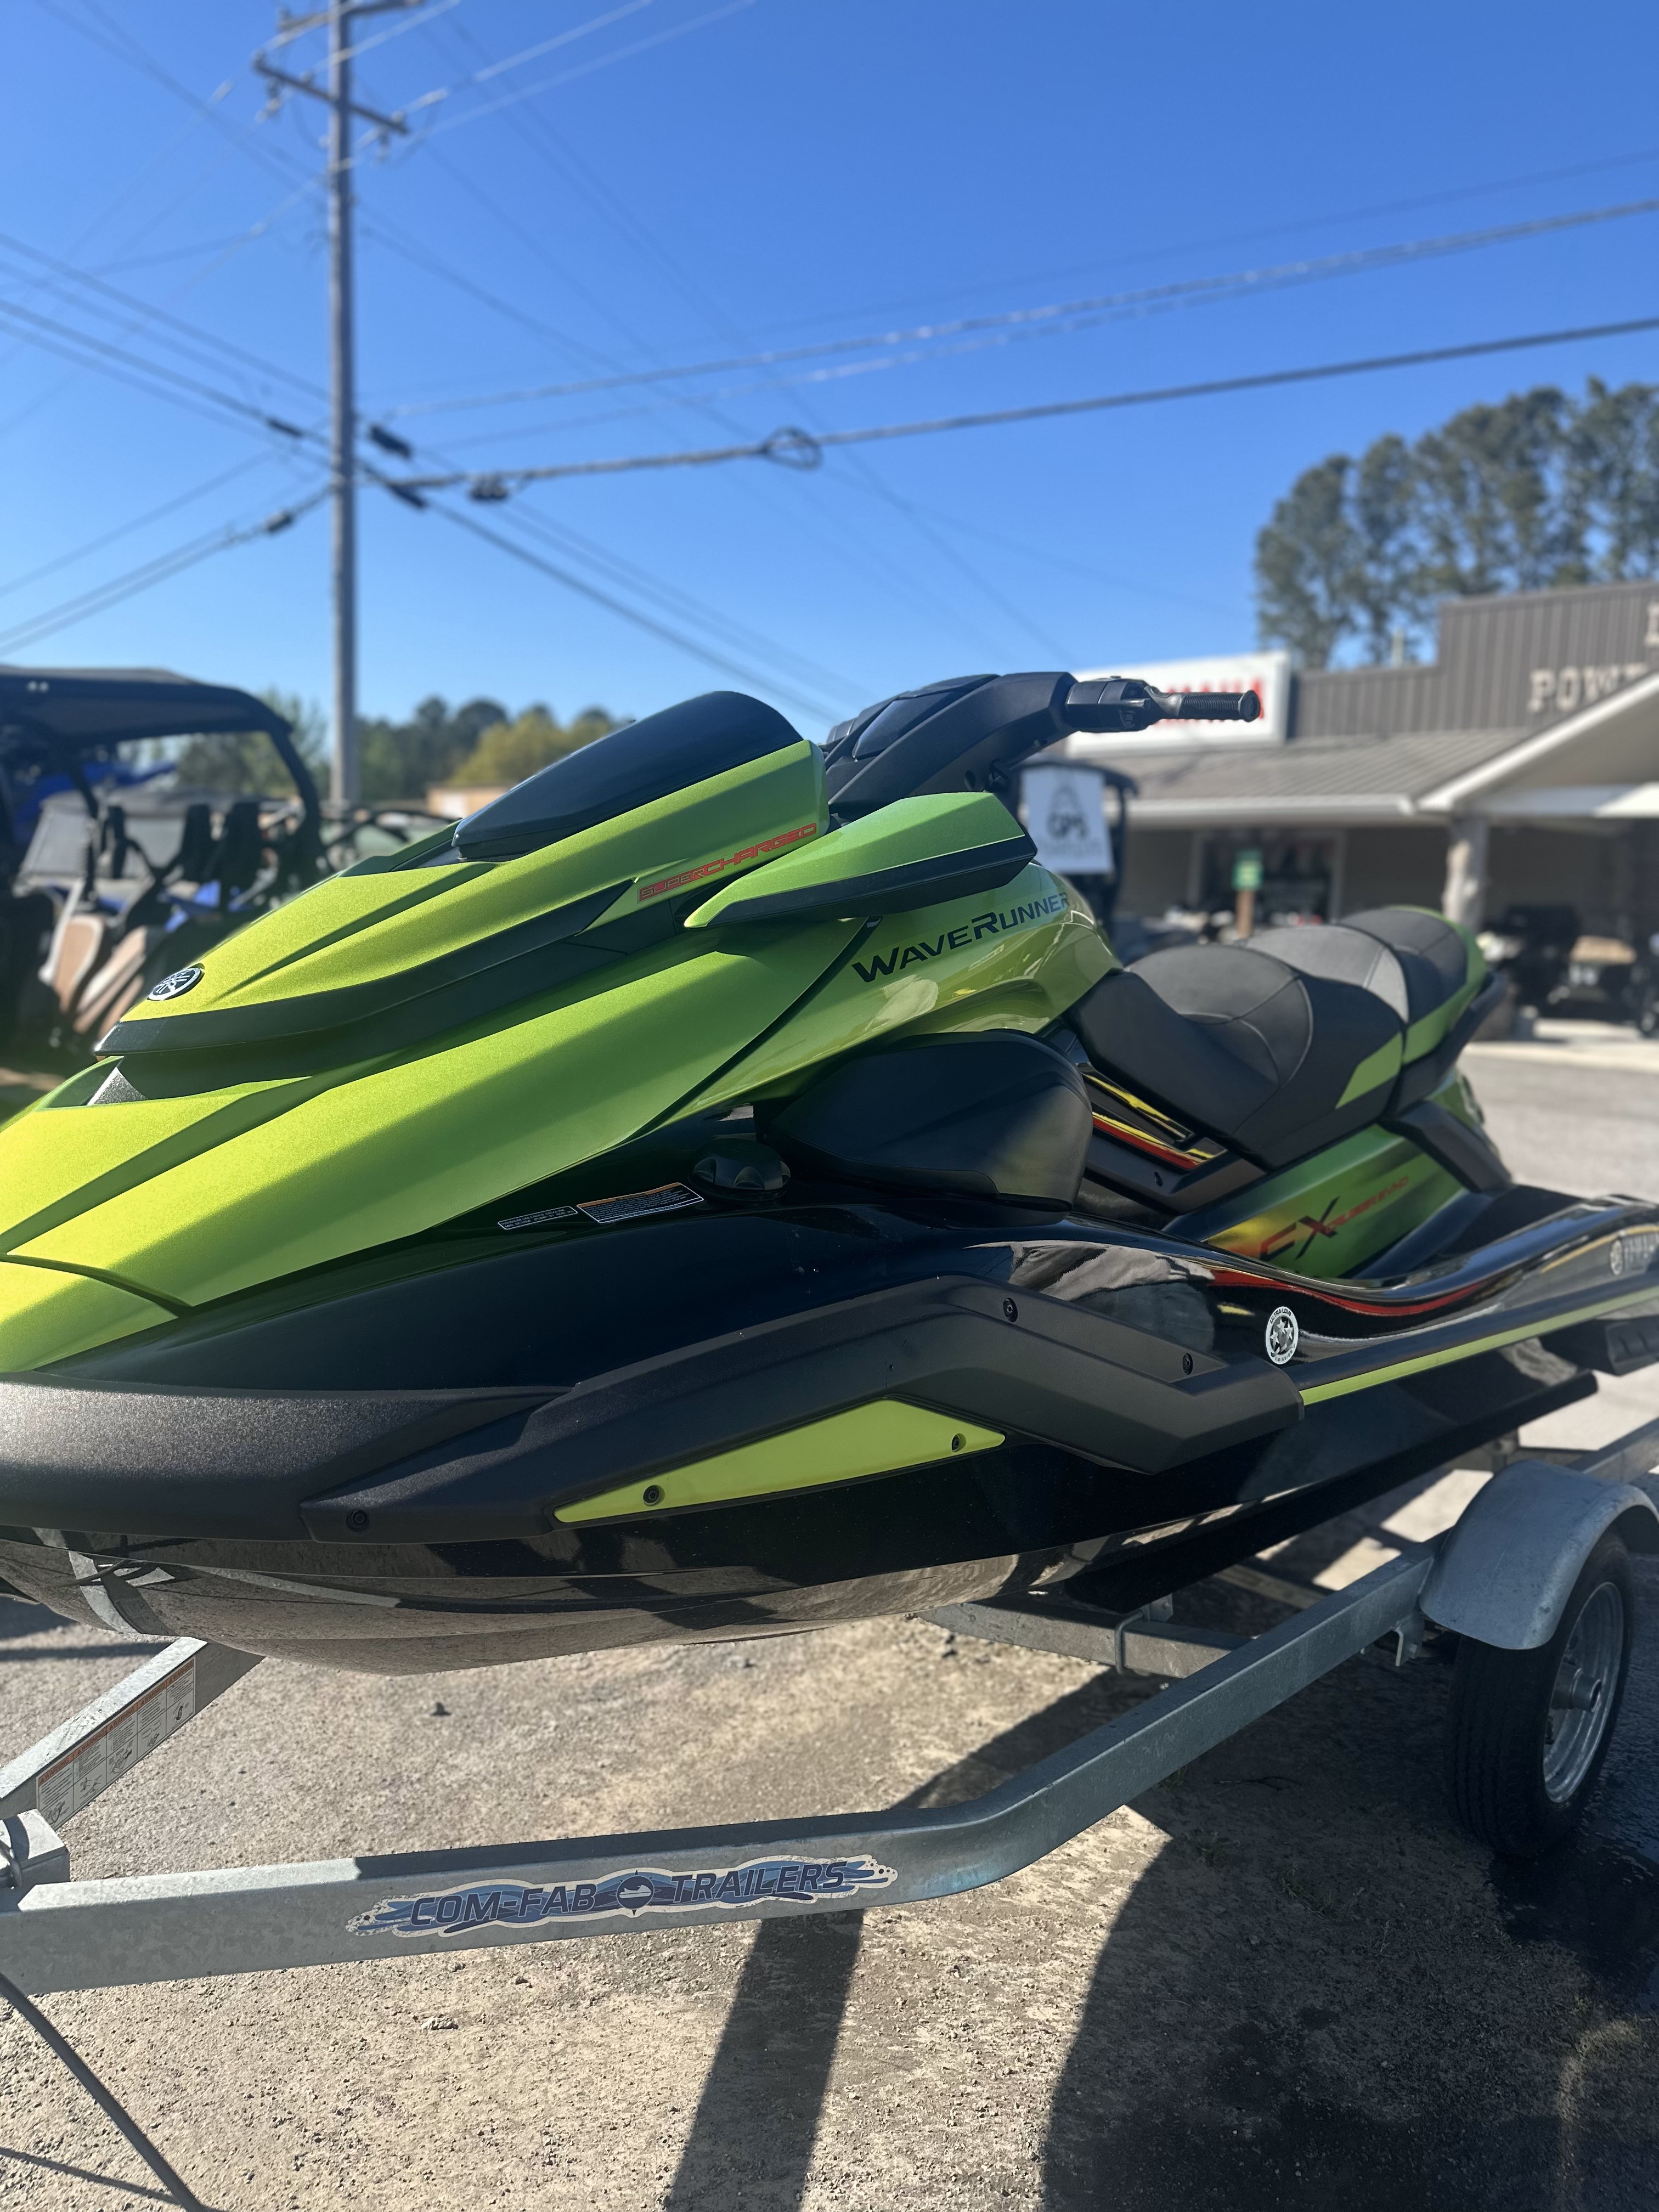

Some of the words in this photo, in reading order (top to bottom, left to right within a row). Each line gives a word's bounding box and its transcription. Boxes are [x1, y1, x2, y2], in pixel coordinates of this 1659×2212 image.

[639, 823, 816, 896] SUPERCHARGED
[851, 892, 1069, 983] WAVERUNNER
[1270, 1308, 1291, 1324] ULTRA-LOW
[410, 1883, 597, 1926] COM-FAB
[670, 1861, 848, 1903] TRAILERS
